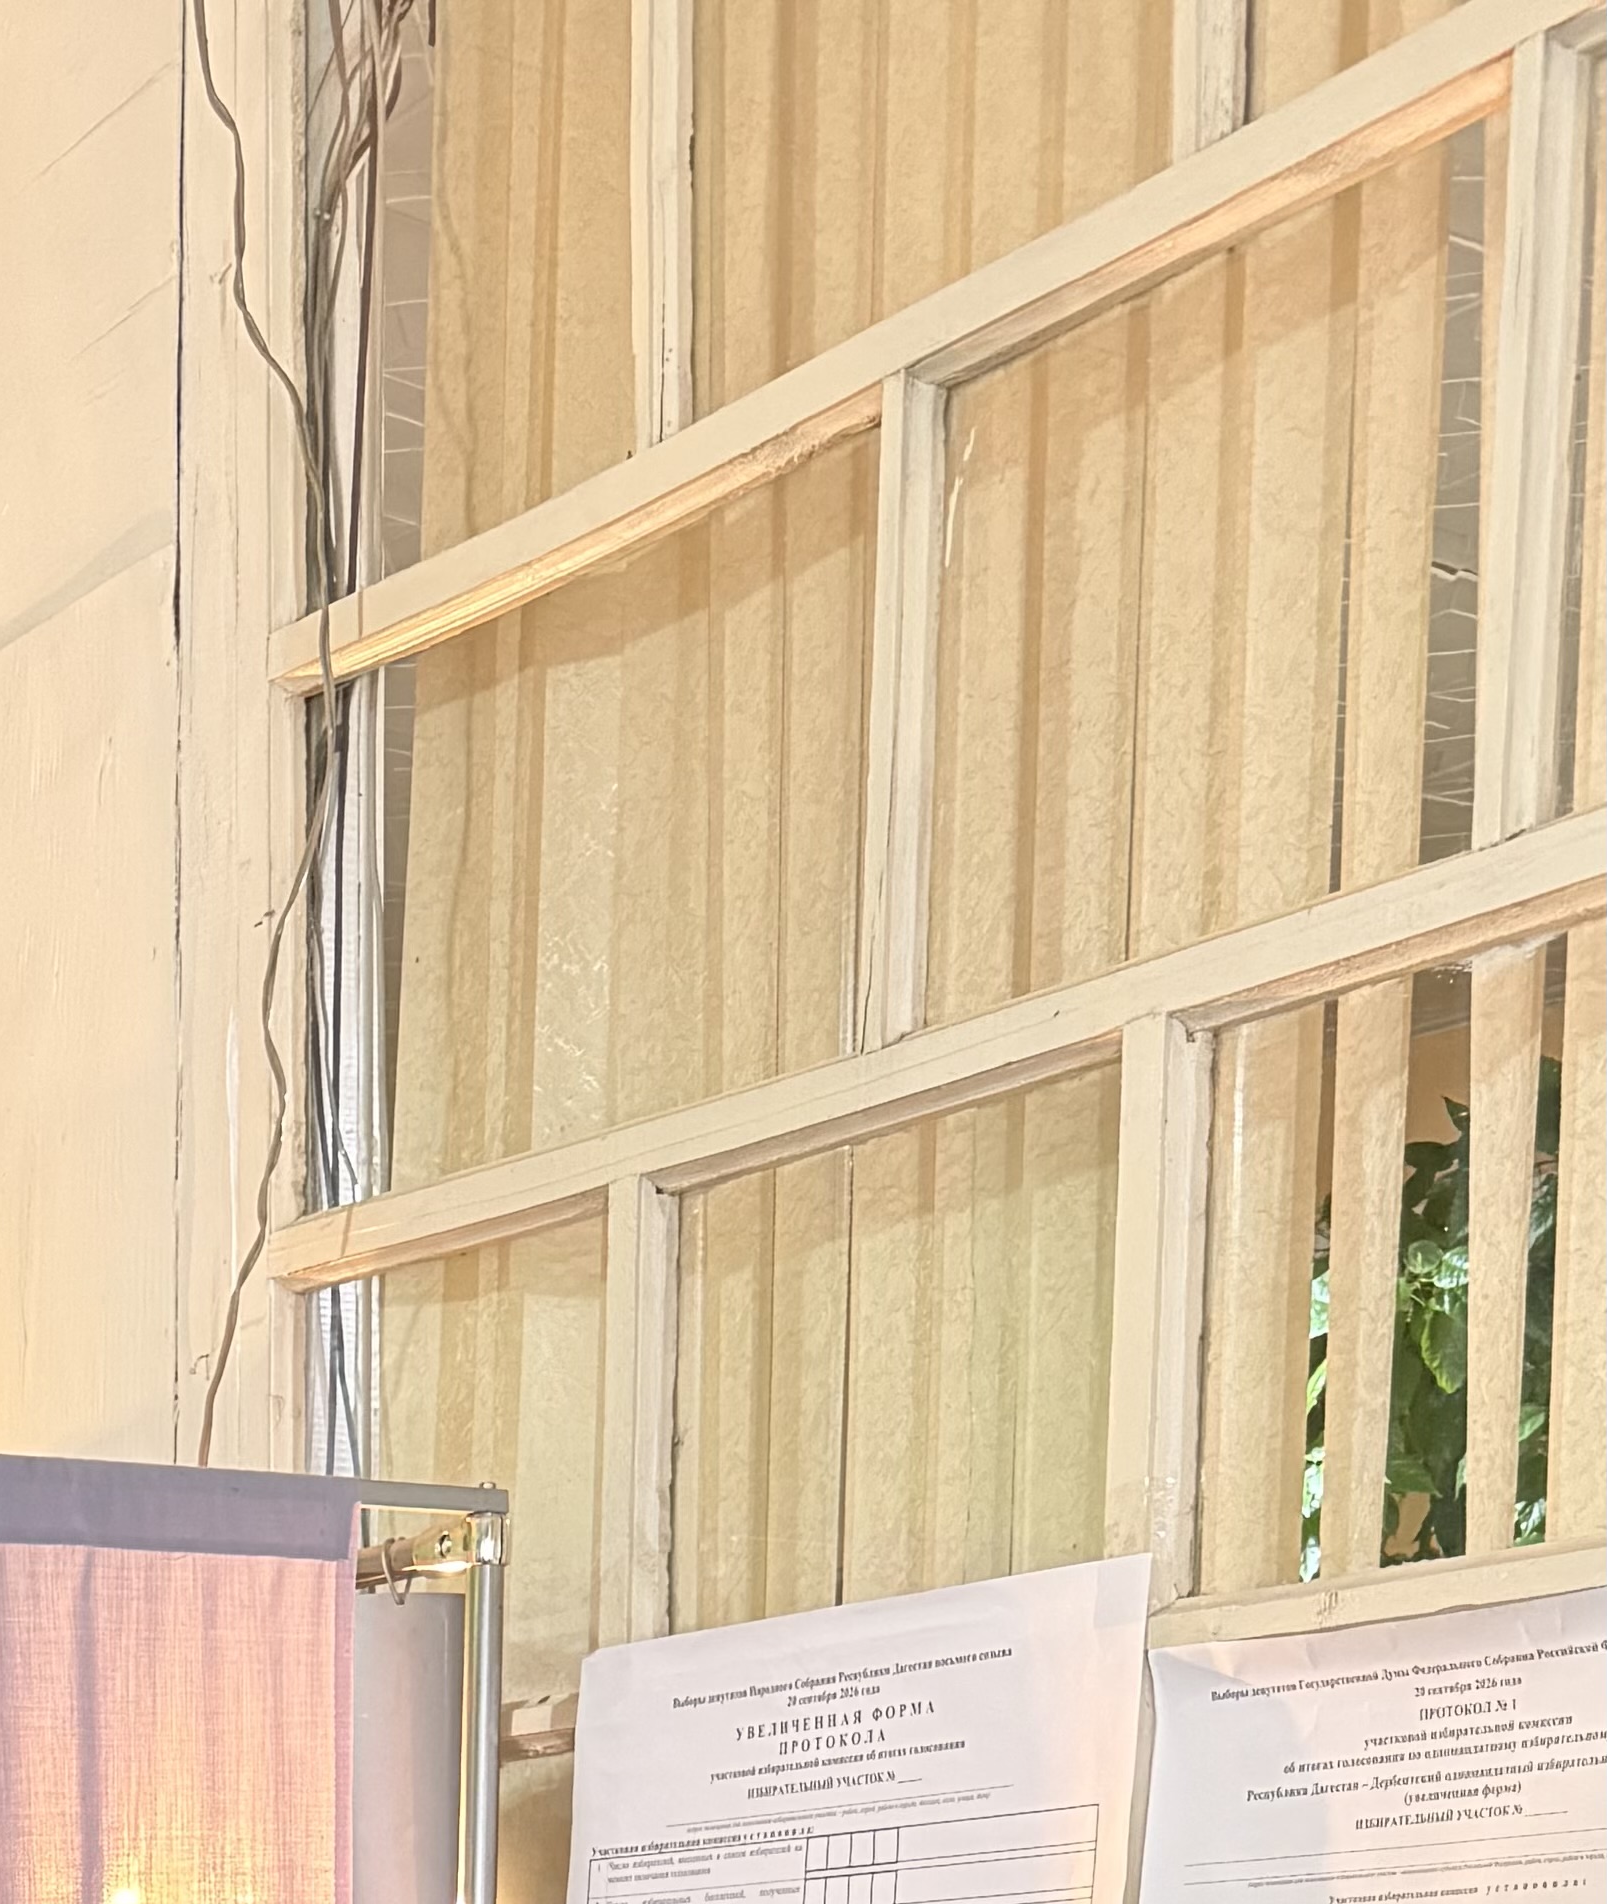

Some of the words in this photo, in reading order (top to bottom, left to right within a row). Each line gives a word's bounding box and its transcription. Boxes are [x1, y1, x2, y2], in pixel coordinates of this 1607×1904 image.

[893, 1661, 932, 1675] Дагестан
[1476, 1678, 1497, 1690] 2026
[840, 1687, 859, 1699] 2026
[1420, 1702, 1491, 1720] ПРОТОКОЛ
[737, 1710, 861, 1741] УВЕЛИЧЕННАЯ
[873, 1702, 934, 1721] ФОРМА
[780, 1729, 885, 1755] ПРОТОКОЛА
[837, 1772, 883, 1787] УЧАСТОК
[1311, 1783, 1358, 1796] Дагестан
[1356, 1809, 1453, 1829] ИЗБИРАТЕЛЬНЫЙ
[1457, 1805, 1510, 1820] УЧАСТОК
